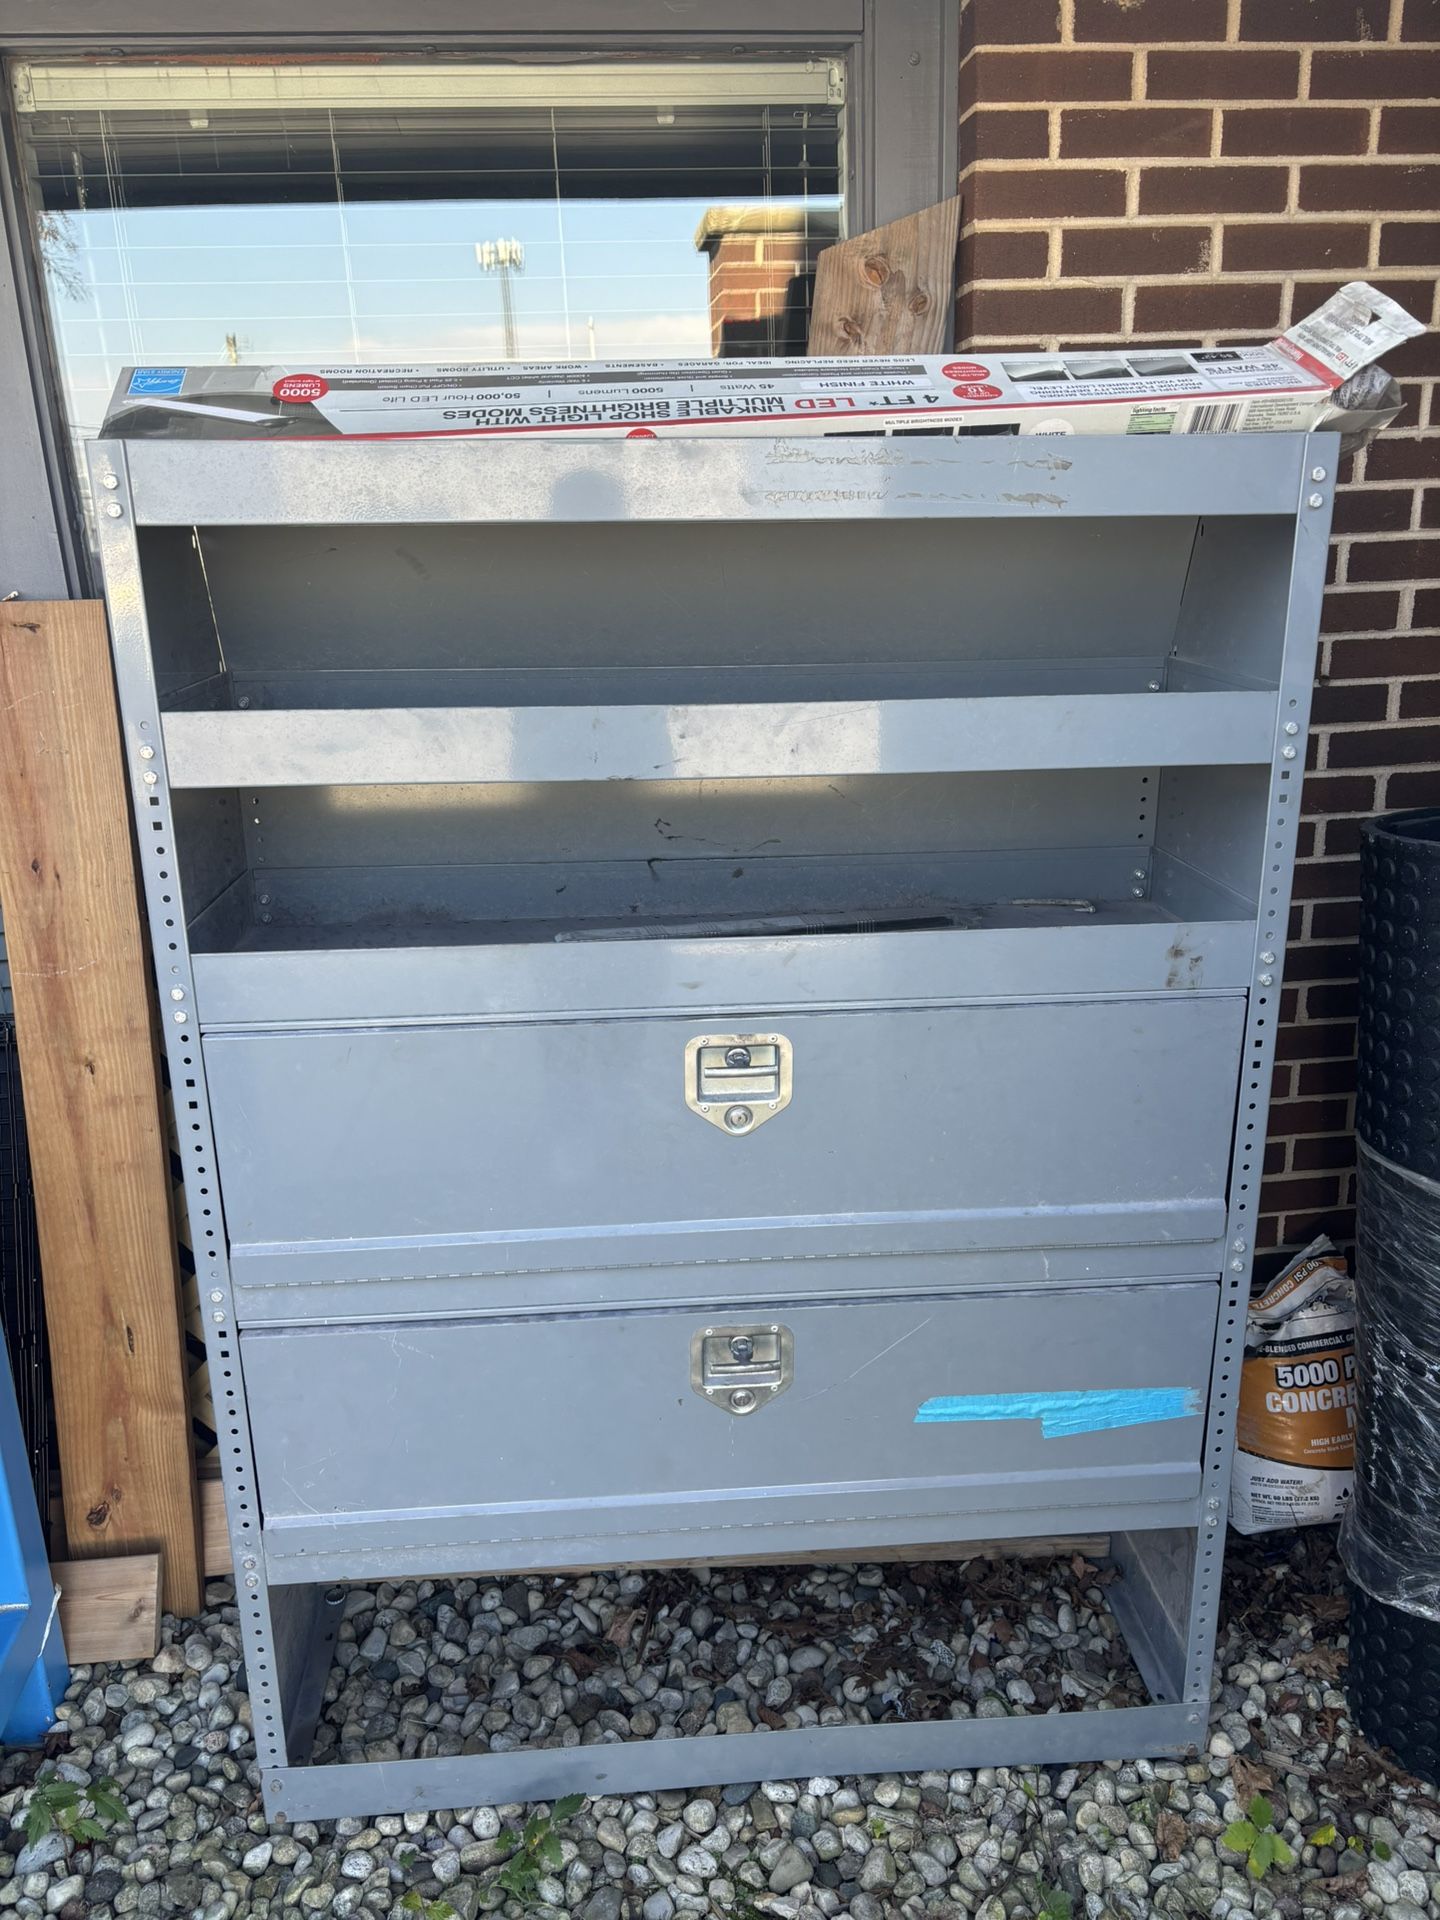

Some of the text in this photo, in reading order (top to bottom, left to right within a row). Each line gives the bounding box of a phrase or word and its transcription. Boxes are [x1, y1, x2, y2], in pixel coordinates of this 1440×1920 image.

[1205, 364, 1257, 372] WATTS
[279, 388, 321, 397] 5000
[443, 394, 475, 402] Hour
[476, 393, 521, 401] 50,000
[923, 394, 939, 404] 4
[443, 396, 784, 420] MULTIPLE BRIGHTNESS MODES
[795, 397, 855, 409] LED
[475, 404, 786, 426] LINKABLE SHOP LIGHT WITH
[1293, 1268, 1308, 1282] PSI
[1298, 1335, 1345, 1350] COMMERCIAL
[1276, 1359, 1340, 1388] 5000
[1311, 1437, 1329, 1447] HIGH
[1331, 1432, 1354, 1444] EARLY
